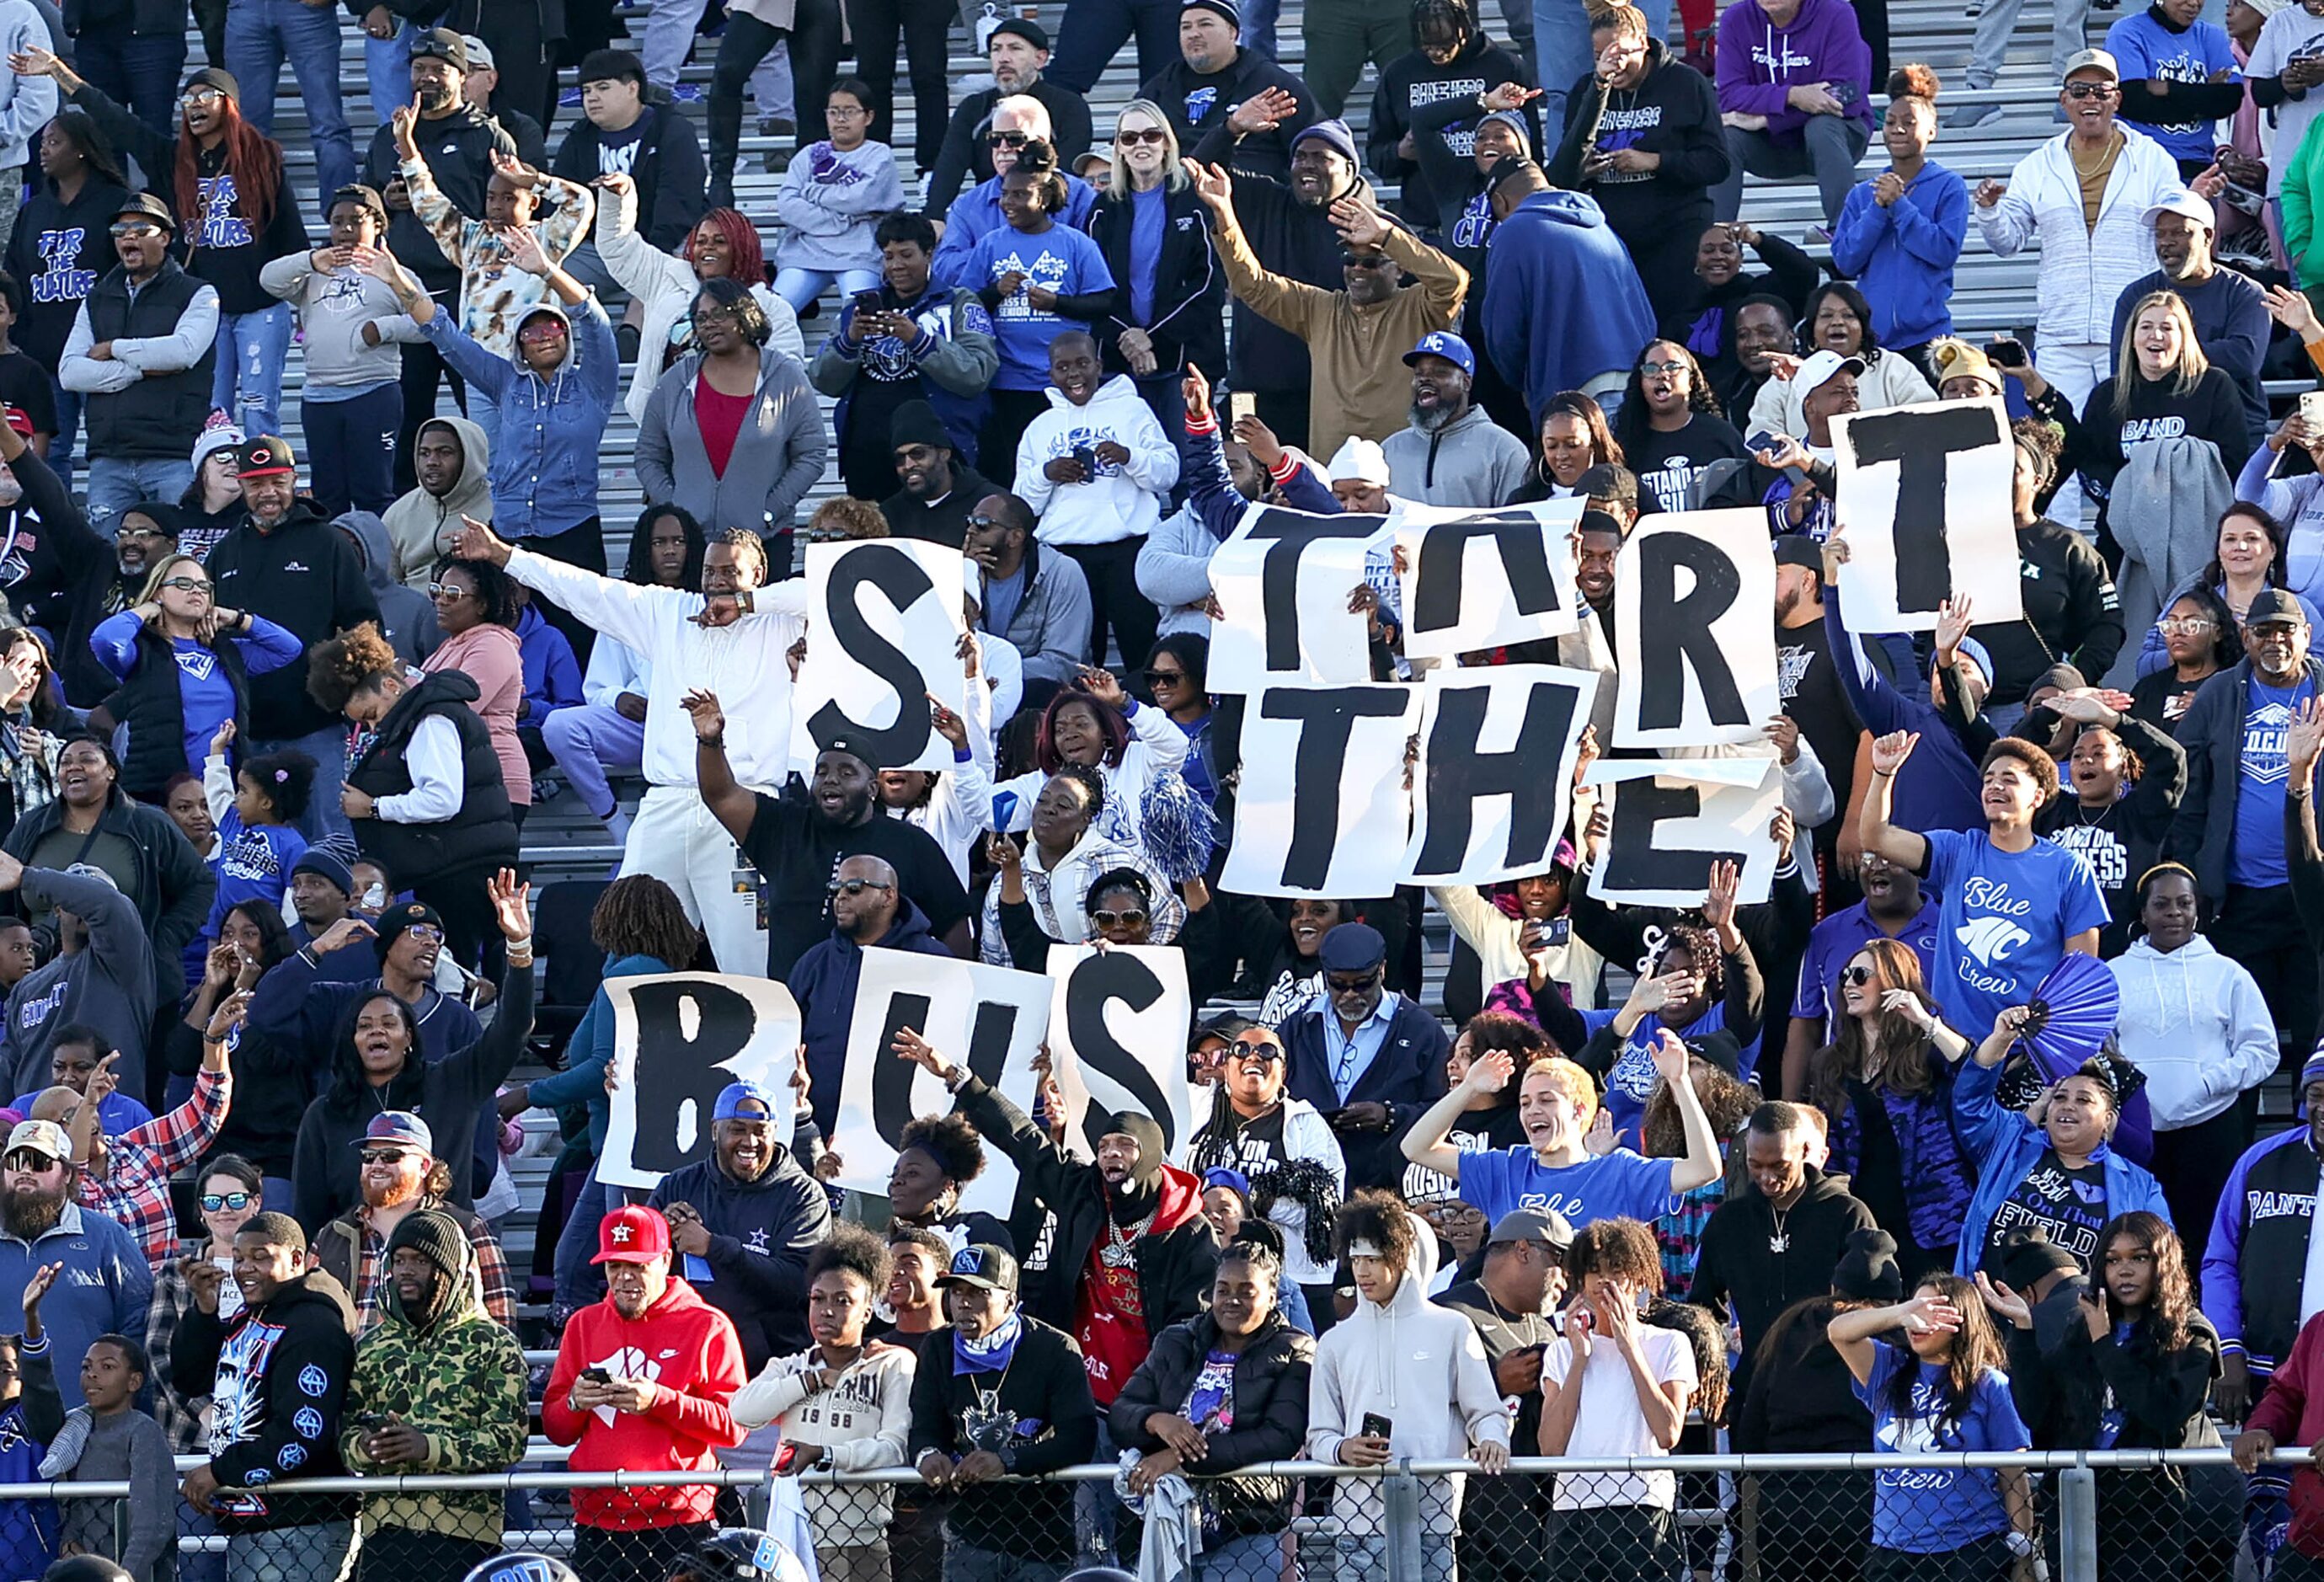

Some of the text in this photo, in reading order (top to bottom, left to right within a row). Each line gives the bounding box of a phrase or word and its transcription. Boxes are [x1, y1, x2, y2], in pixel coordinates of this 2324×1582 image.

[1424, 334, 1444, 352] NC
[2122, 417, 2186, 441] BAND
[1849, 406, 2001, 613] T
[1639, 532, 1750, 731] R
[807, 543, 933, 770] S
[2092, 828, 2115, 847] ON
[1964, 876, 2031, 916] Blue
[1958, 956, 2017, 995] Crew
[2026, 1192, 2054, 1216] On
[2247, 1190, 2317, 1228] PANT
[1881, 1467, 1953, 1489] Crew
